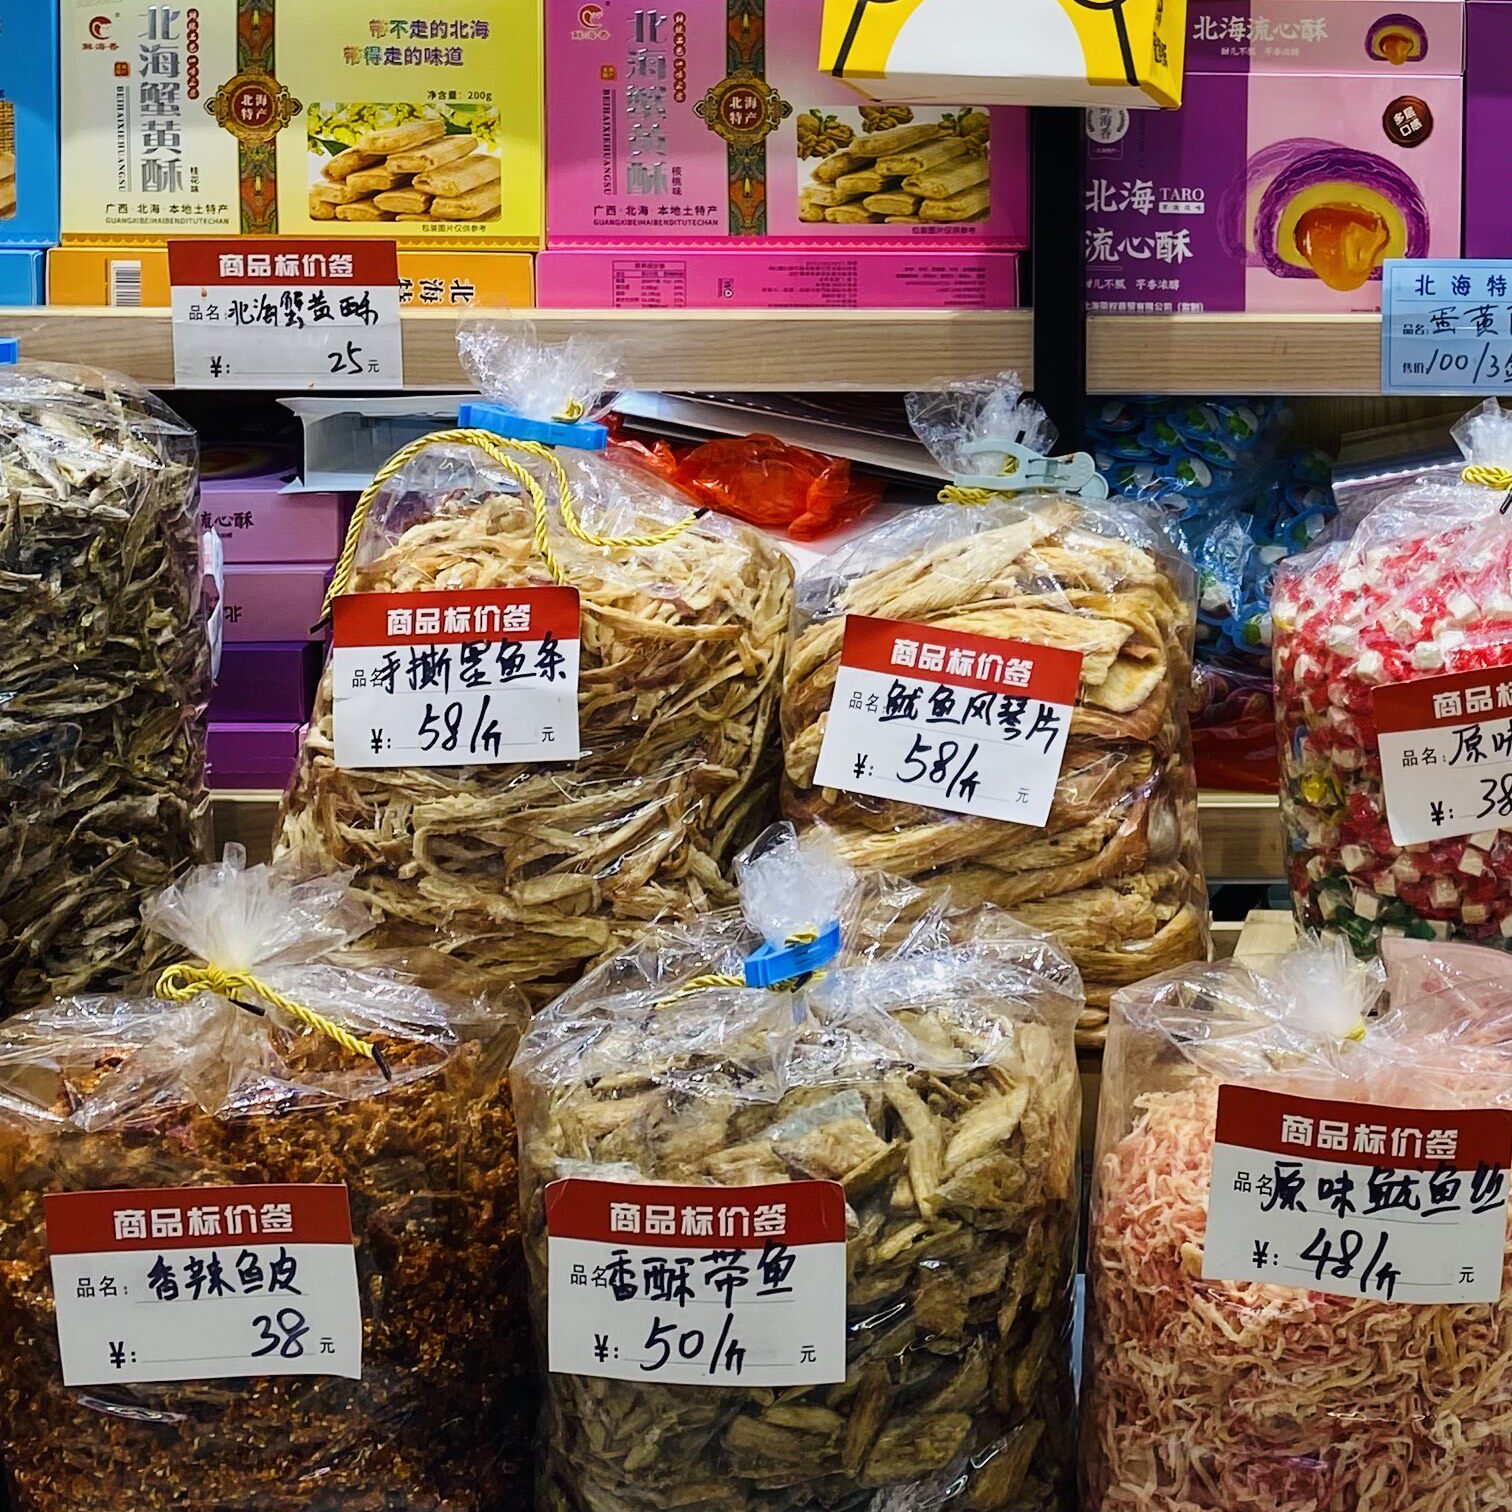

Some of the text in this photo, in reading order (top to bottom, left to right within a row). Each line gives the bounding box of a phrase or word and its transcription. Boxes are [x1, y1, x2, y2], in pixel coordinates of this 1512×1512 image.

[369, 19, 491, 40] 带不走的北海
[1193, 15, 1327, 43] 北海流心酥
[344, 46, 464, 68] 带得走的味道
[137, 4, 183, 194] 北海蟹黄酥
[1085, 180, 1205, 214] 北海 TARO
[1085, 228, 1193, 264] 流心酥
[218, 253, 354, 279] 商品标价签
[329, 341, 364, 375] 25
[387, 604, 531, 636] 商品标价签
[890, 638, 1035, 688] 商品标价签
[1281, 1114, 1458, 1160] 商品标价签
[1261, 1161, 1506, 1219] 原味鱿鱼丝
[113, 1203, 293, 1239] 商品标价签
[610, 1202, 786, 1237] 商品标价签
[147, 1247, 301, 1301] 香辣鱼皮
[605, 1240, 796, 1309] 香酥带鱼
[251, 1308, 310, 1358] 38
